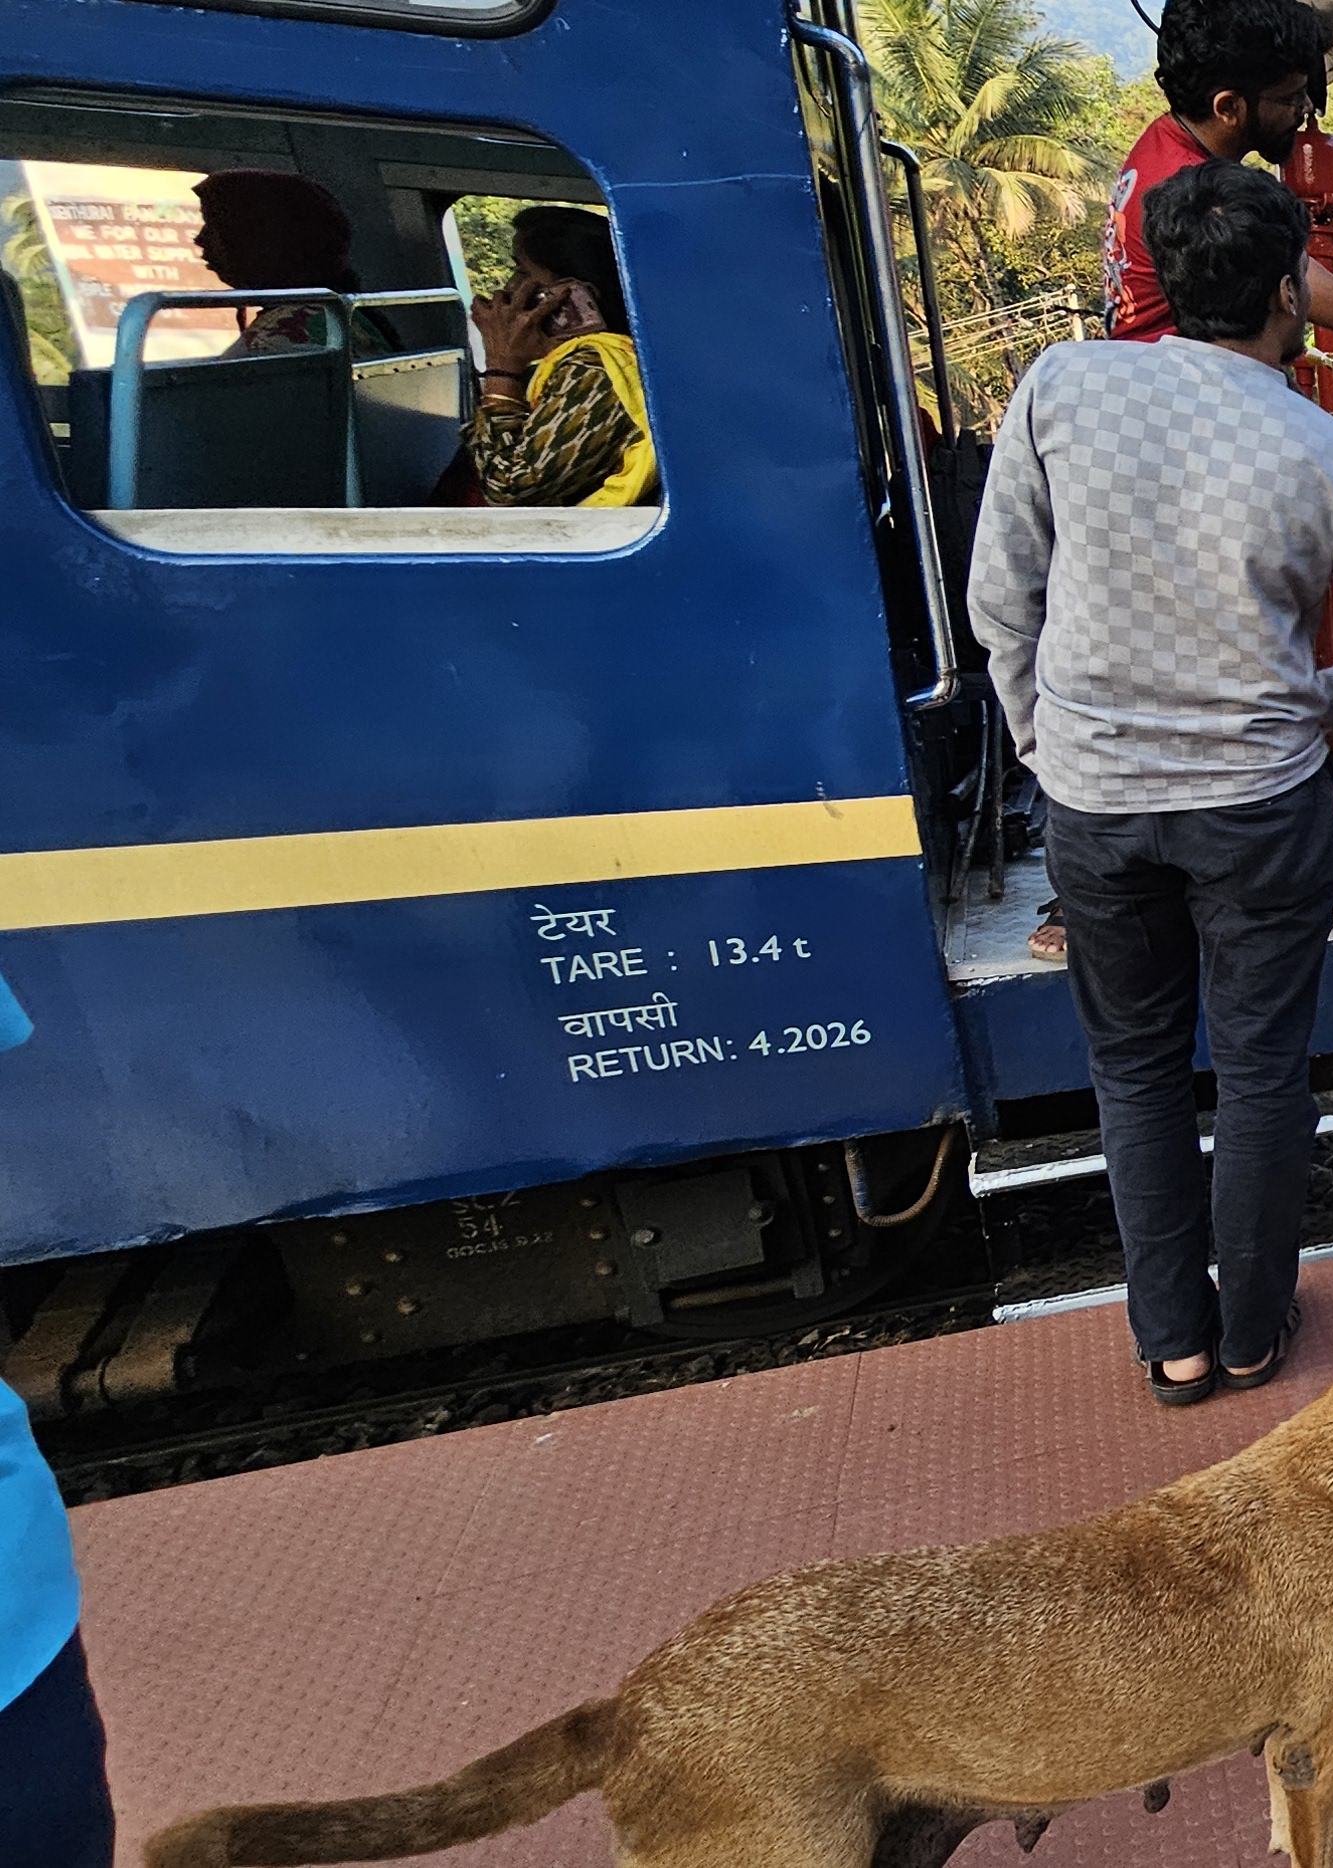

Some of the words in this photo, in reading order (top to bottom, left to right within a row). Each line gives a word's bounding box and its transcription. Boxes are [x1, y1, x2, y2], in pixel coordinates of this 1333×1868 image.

[530, 903, 617, 941] टेयर
[540, 948, 648, 984] TARE
[792, 937, 812, 958] t
[557, 991, 679, 1038] वापसी
[568, 1035, 738, 1082] RETURN:
[748, 1019, 872, 1057] 4.2026
